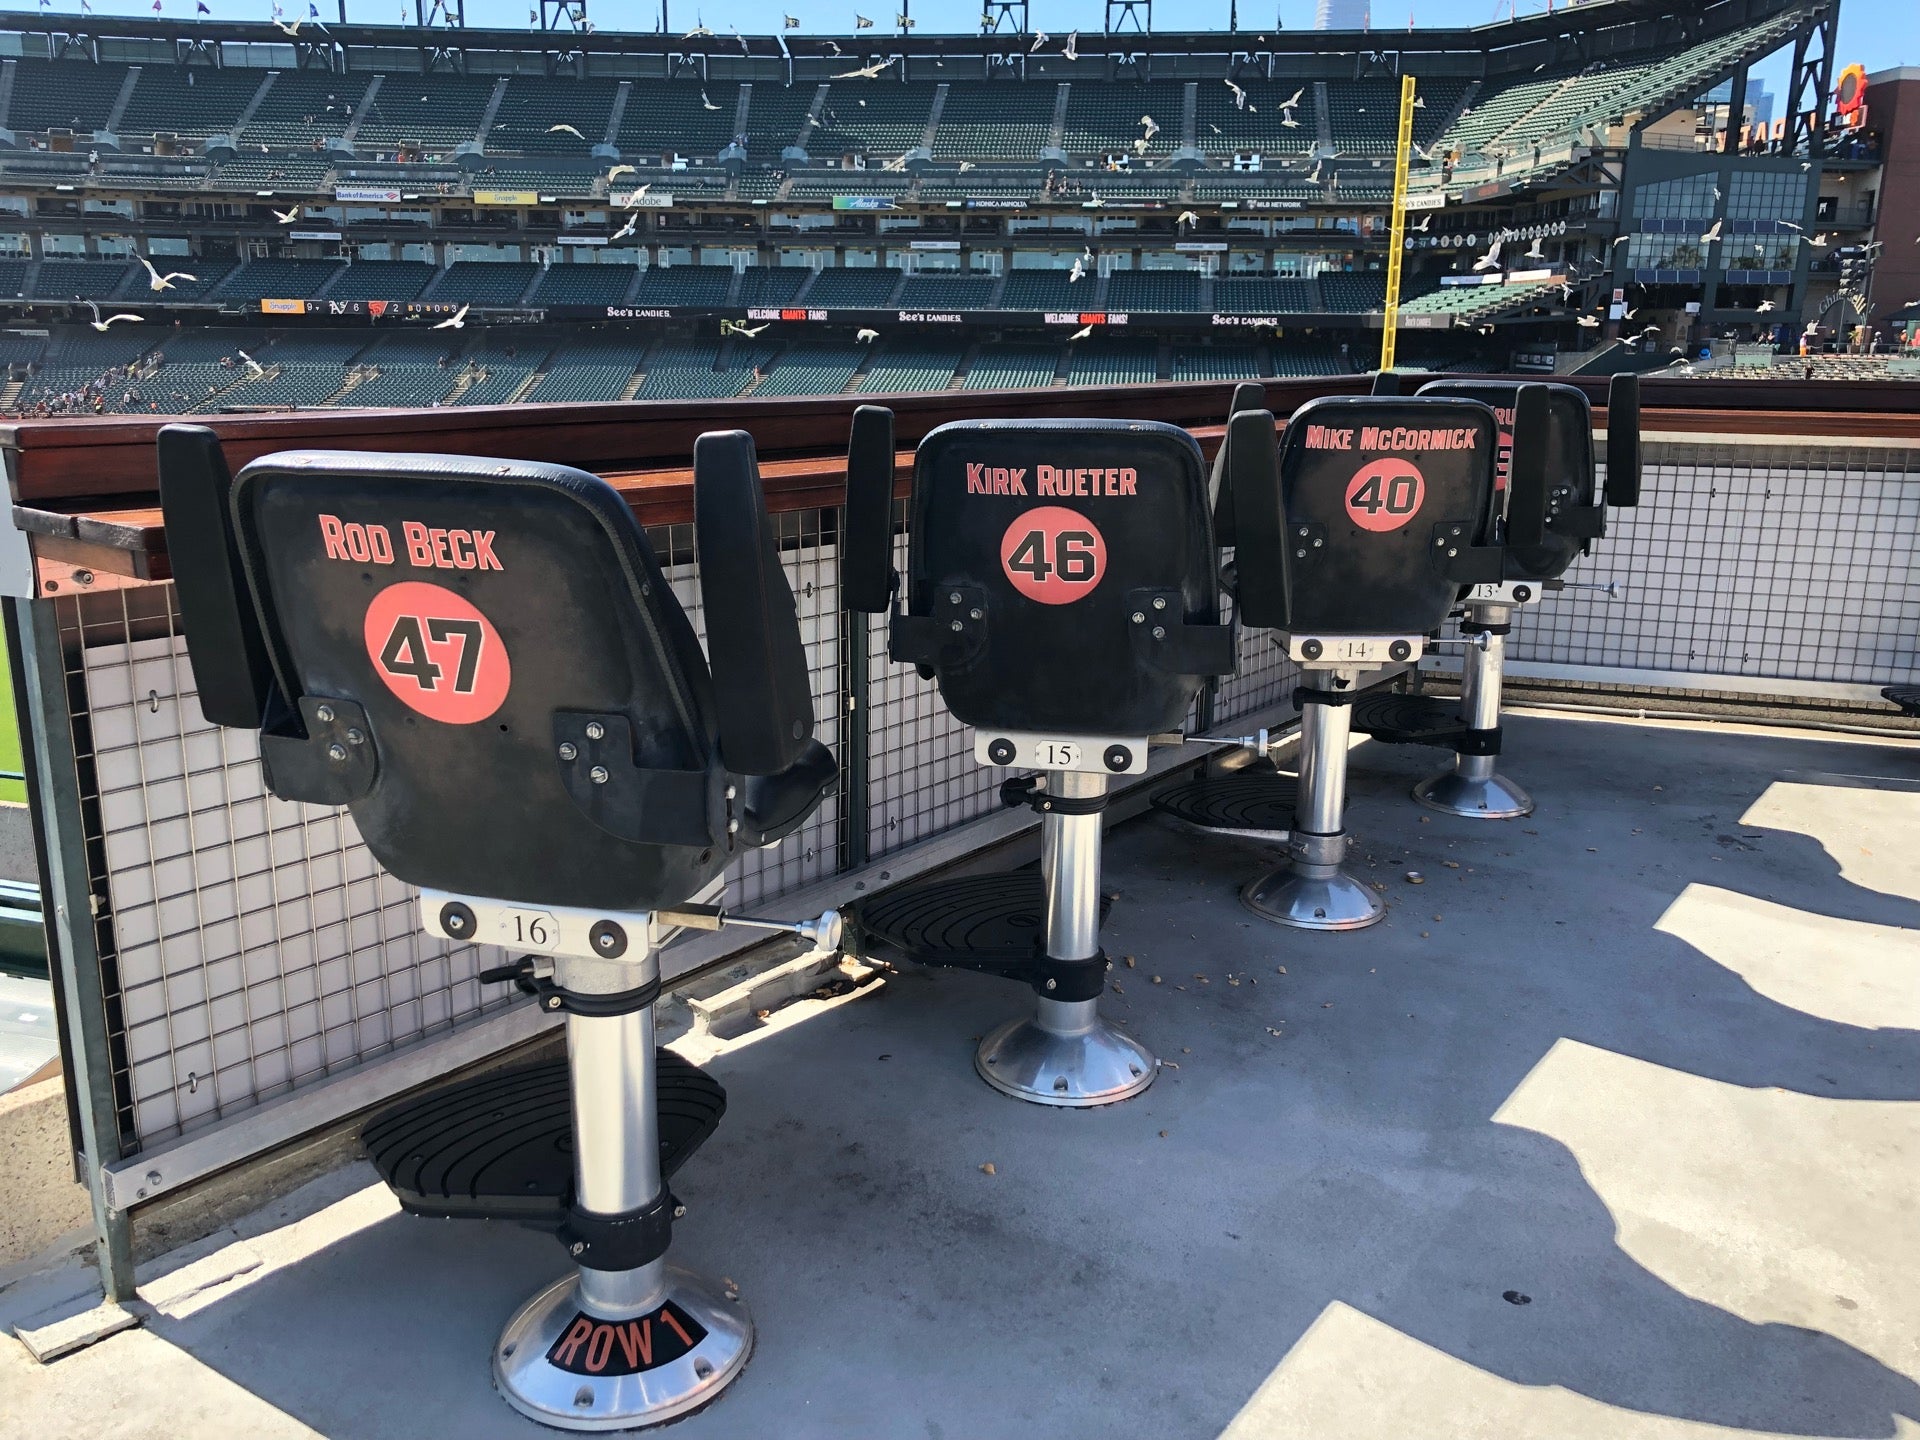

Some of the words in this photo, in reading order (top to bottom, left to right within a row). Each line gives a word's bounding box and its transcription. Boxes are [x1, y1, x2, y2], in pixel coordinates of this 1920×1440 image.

[633, 197, 662, 206] Adobe
[849, 198, 878, 209] Alaska
[270, 302, 296, 310] Snapple
[306, 303, 312, 311] 9
[353, 303, 359, 312] 6
[392, 304, 399, 312] 2
[452, 304, 457, 312] 3
[607, 306, 633, 317] See's
[747, 309, 780, 320] WELCOME
[782, 309, 806, 320] GIANTS
[808, 310, 828, 320] FANS!
[899, 312, 925, 322] See's
[1044, 313, 1079, 323] WELCOME
[1080, 313, 1105, 324] GIANTS
[1107, 313, 1128, 324] FANS!
[1212, 314, 1239, 325] See's
[1305, 425, 1354, 450] MIKE
[966, 462, 1028, 496] KIRK
[1037, 464, 1137, 496] RUETER
[1349, 475, 1418, 516] 40
[318, 514, 395, 565] ROD
[402, 521, 505, 571] BECK
[1007, 529, 1097, 583] 46
[1477, 584, 1493, 598] 13
[378, 614, 485, 695] 47
[1348, 642, 1366, 658] 14
[1048, 745, 1072, 765] 15
[514, 915, 548, 944] 16
[553, 1317, 653, 1373] ROW
[659, 1309, 694, 1347] 1
